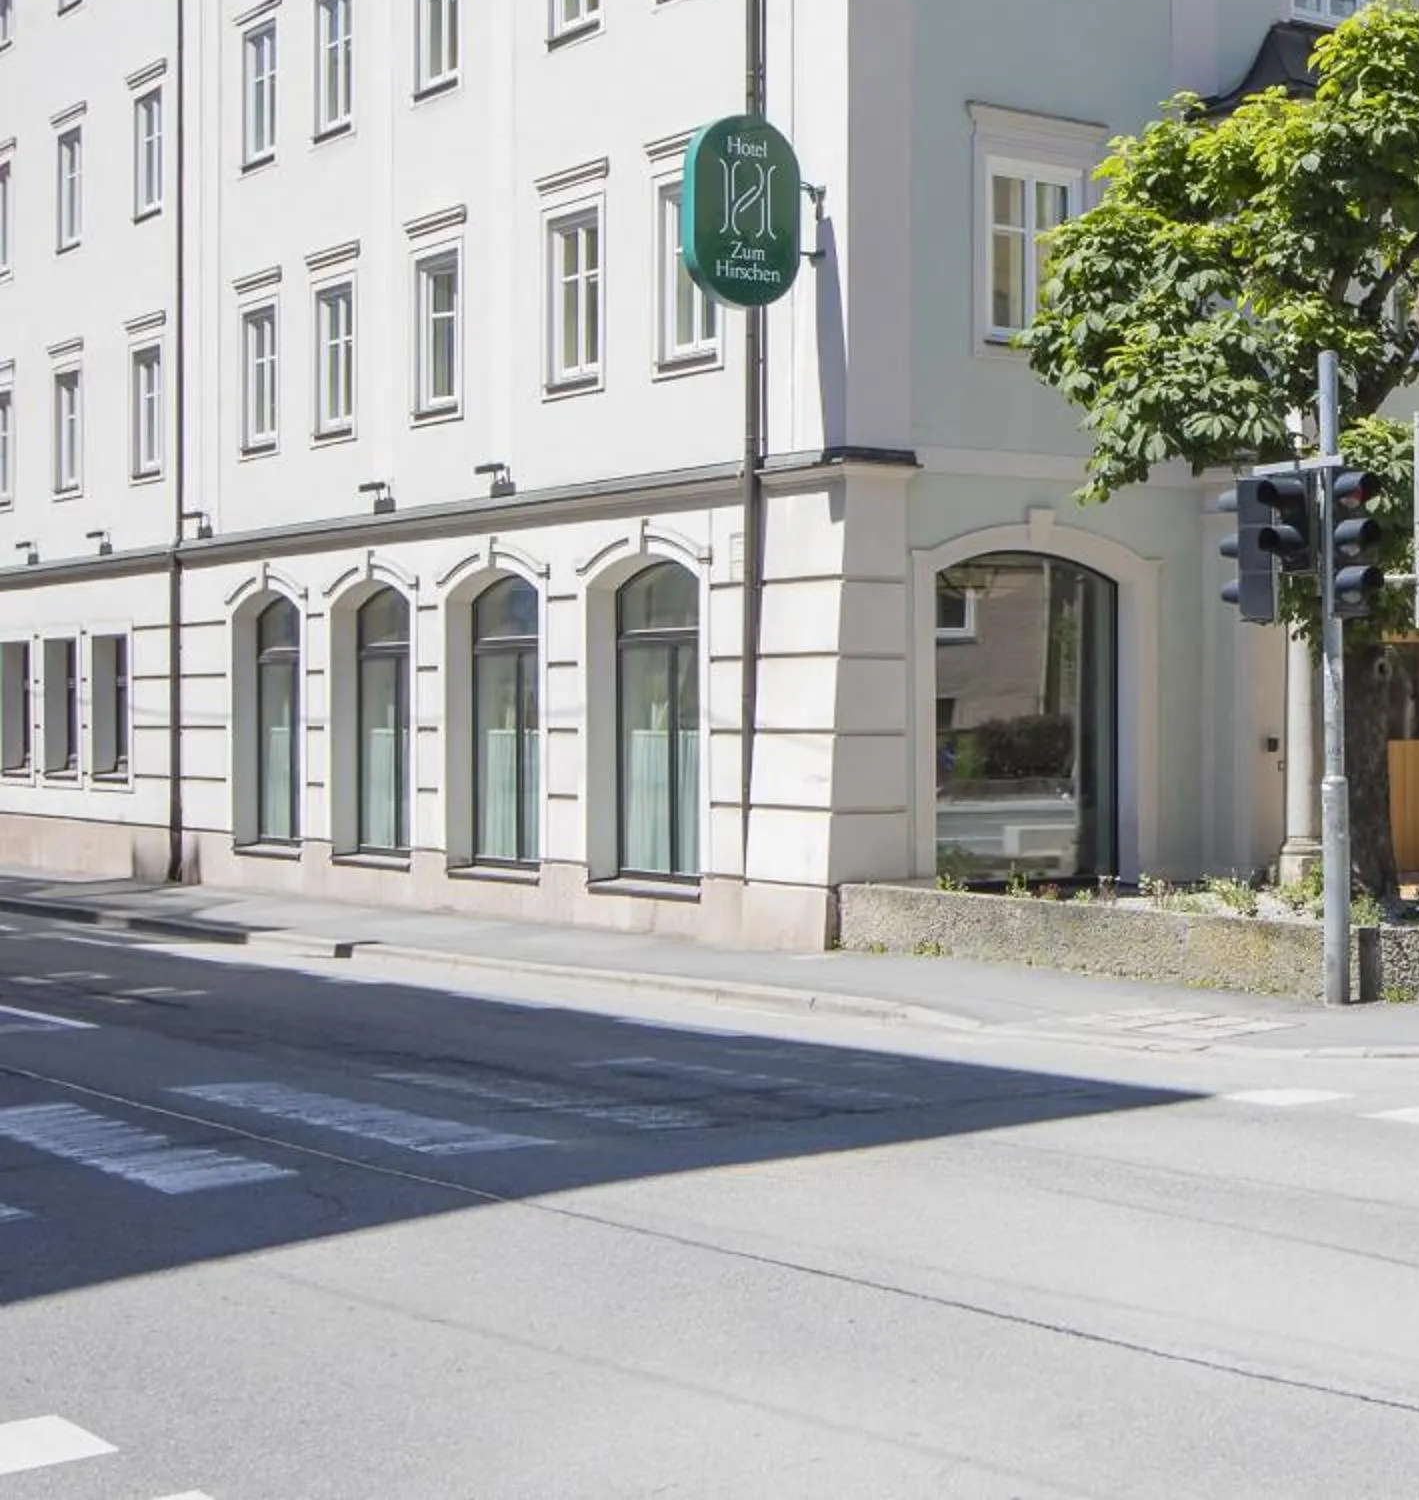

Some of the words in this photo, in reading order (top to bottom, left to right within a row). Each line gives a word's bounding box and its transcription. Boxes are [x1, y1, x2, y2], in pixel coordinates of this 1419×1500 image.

[727, 135, 768, 158] Hotel
[730, 240, 766, 261] Zum
[715, 260, 781, 283] Hirschen
